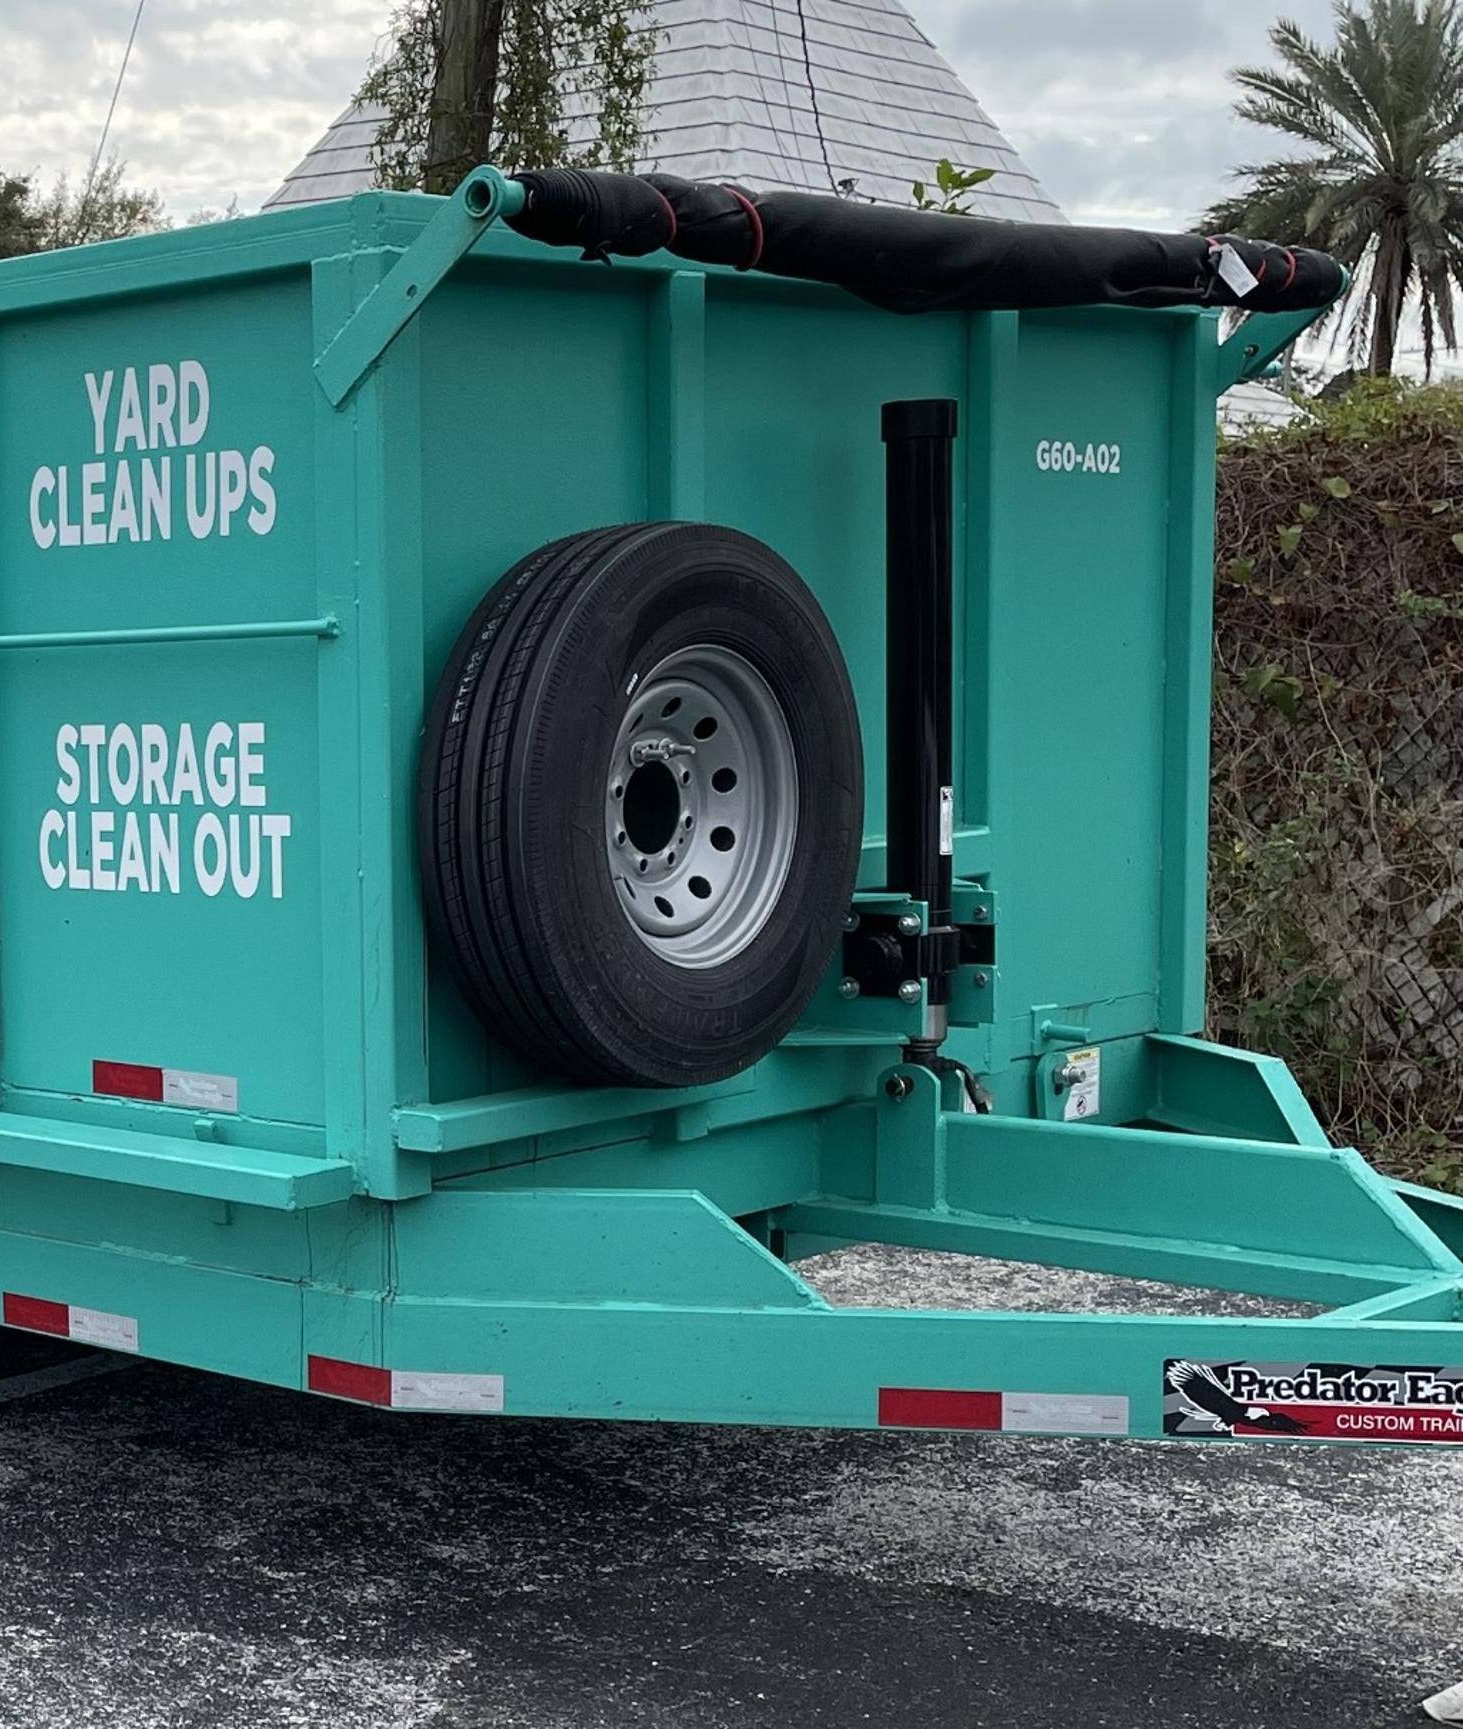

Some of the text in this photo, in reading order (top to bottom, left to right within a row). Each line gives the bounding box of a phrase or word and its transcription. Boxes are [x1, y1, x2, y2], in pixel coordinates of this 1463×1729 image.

[84, 359, 210, 455] YARD
[30, 445, 277, 549] CLEAN UPS
[1036, 440, 1120, 473] G60-A02
[56, 721, 266, 807] STORAGE
[40, 809, 291, 899] CLEAN OUT
[1230, 1368, 1397, 1404] Predator
[1336, 1414, 1463, 1432] CUSTOM TRAI
